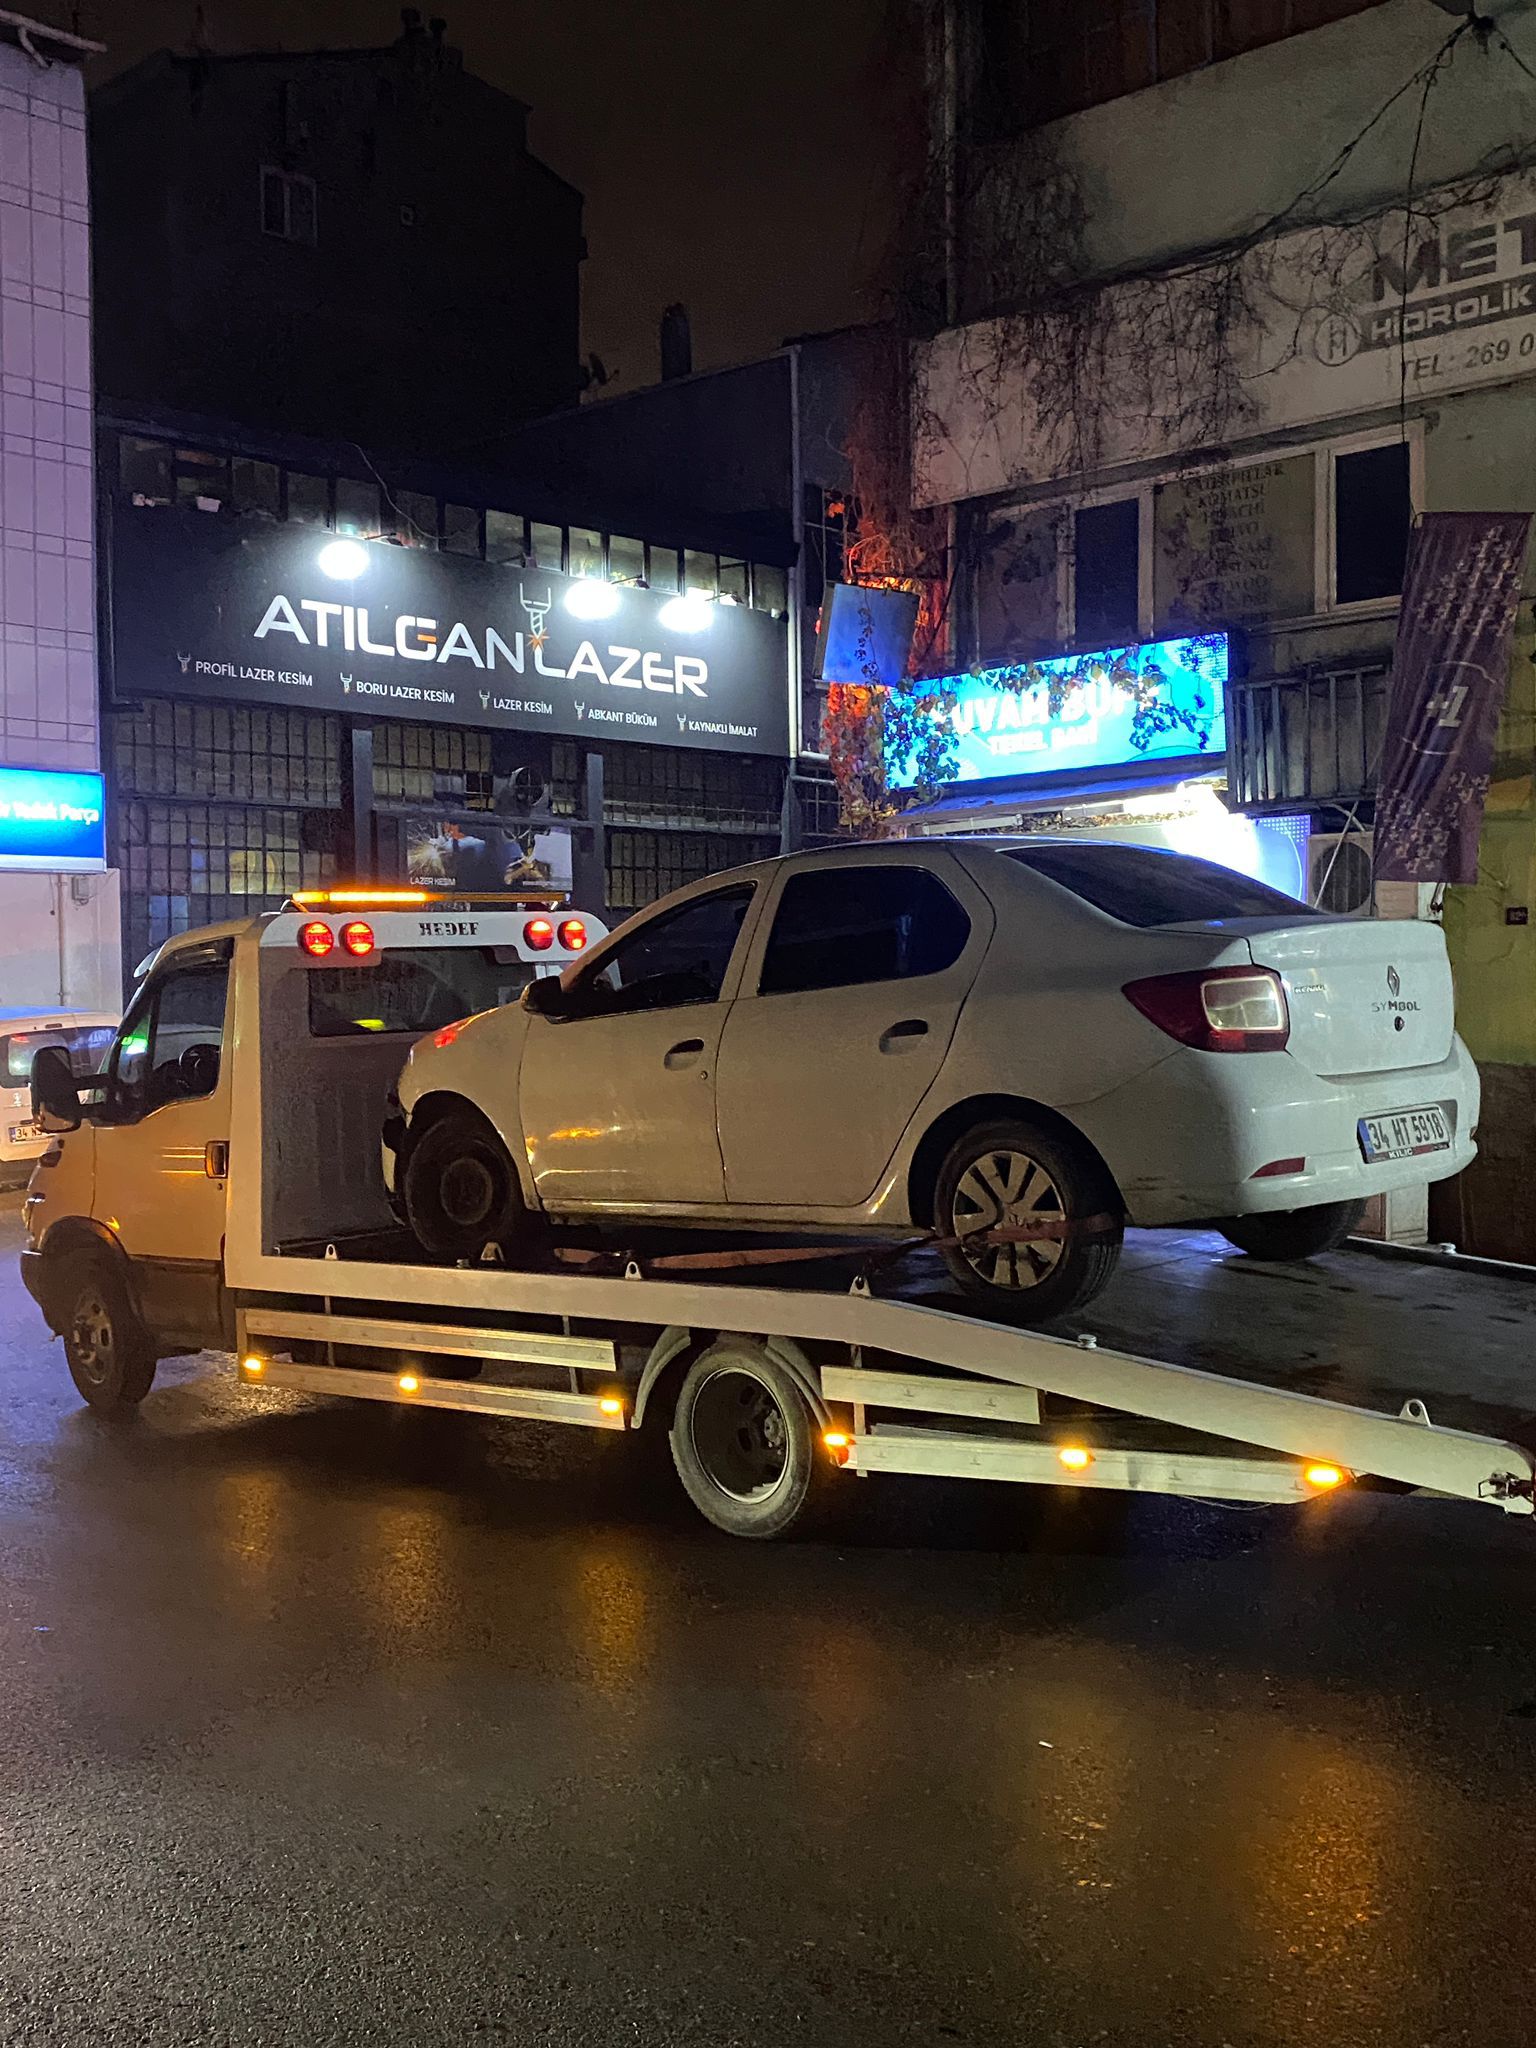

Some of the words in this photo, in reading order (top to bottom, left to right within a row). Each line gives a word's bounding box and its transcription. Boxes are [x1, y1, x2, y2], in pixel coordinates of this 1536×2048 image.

[1465, 338, 1511, 368] 269
[253, 594, 525, 674] ATILGAN
[534, 640, 709, 698] LAZER
[195, 661, 238, 679] PROFİL
[240, 665, 275, 682] LAZER
[278, 669, 313, 687] KESİM
[356, 680, 388, 696] BORU
[390, 684, 421, 700] LAZER
[423, 687, 455, 704] KESİM
[493, 698, 522, 712] LAZER
[524, 700, 553, 715] KESİM
[588, 708, 624, 724] ABKANT
[626, 710, 658, 727] BÜKÜM
[1426, 686, 1469, 727] +1
[688, 720, 728, 735] KAYNAKLI
[728, 721, 758, 738] İMALAT
[418, 922, 479, 936] HEDEF
[1371, 1001, 1421, 1013] SYMBOL
[1368, 1121, 1391, 1150] 34
[1391, 1117, 1410, 1146] HT
[1411, 1112, 1444, 1144] 5918
